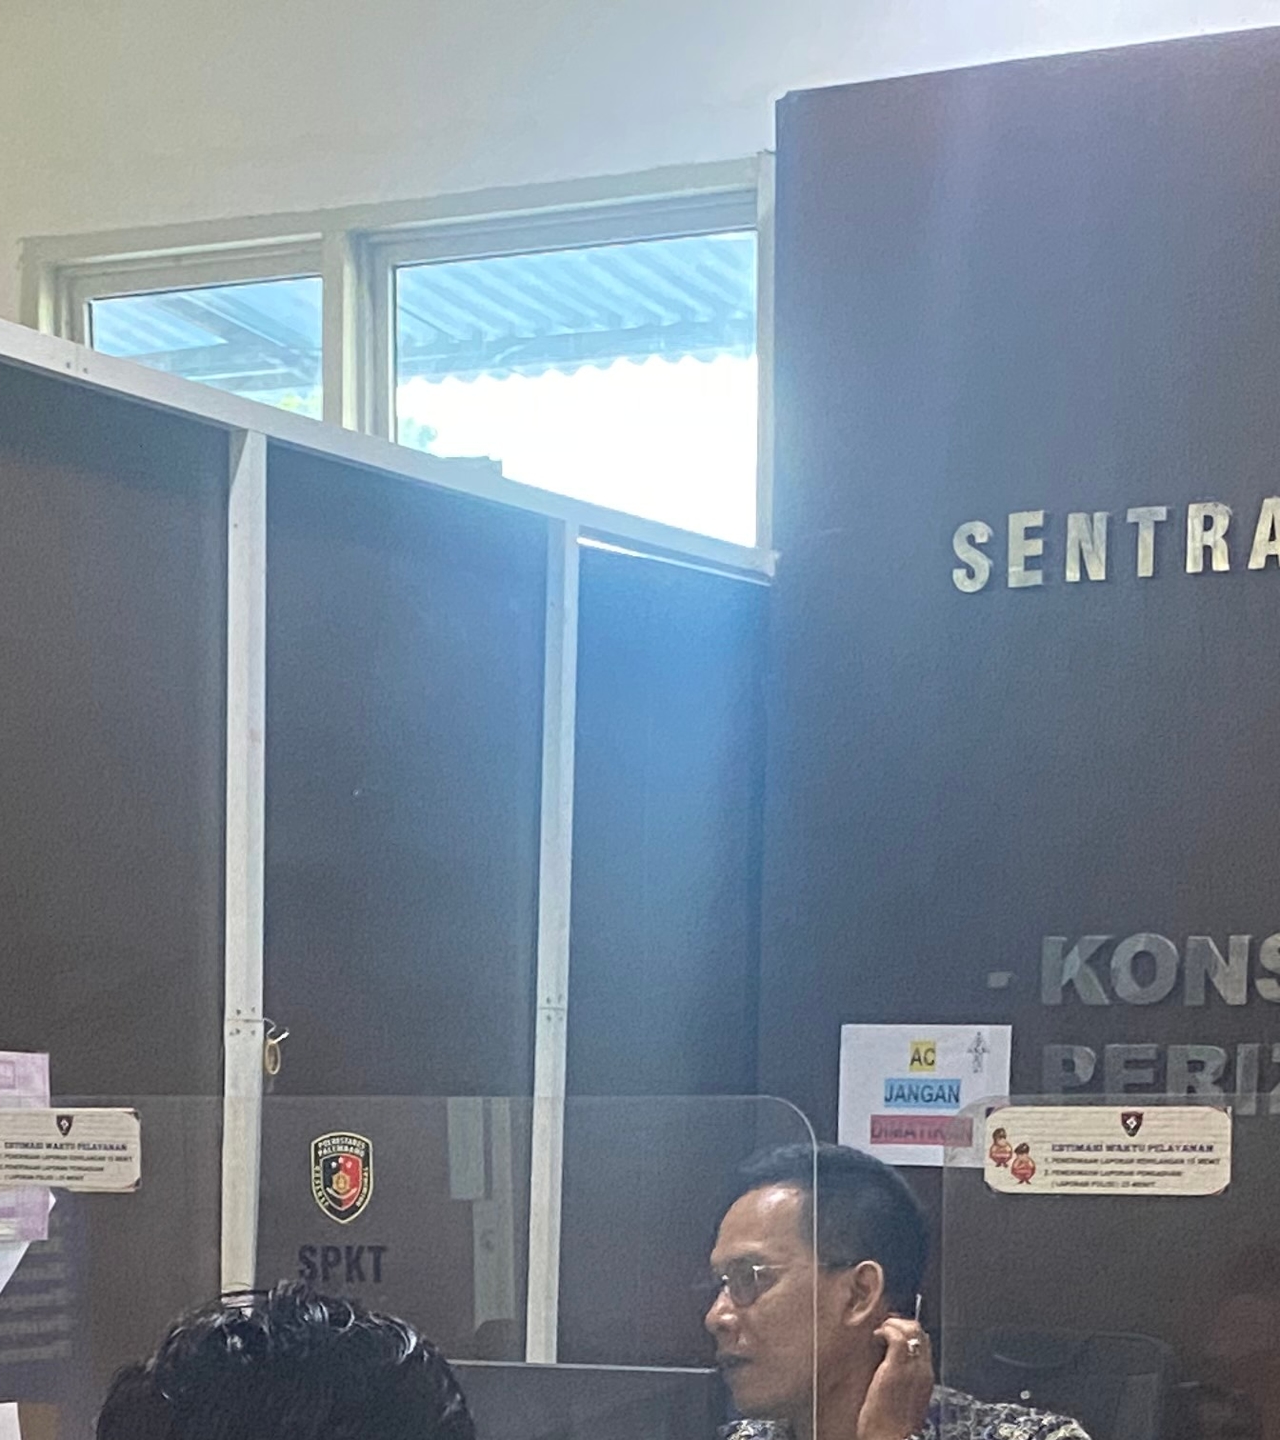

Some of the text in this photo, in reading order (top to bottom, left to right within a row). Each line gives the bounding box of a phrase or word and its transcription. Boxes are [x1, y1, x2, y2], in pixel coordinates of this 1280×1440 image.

[910, 1047, 935, 1066] AC
[884, 1084, 960, 1103] JANGAN
[1052, 1143, 1213, 1153] ESTIMASI WAKTU PELAYANAN
[298, 1245, 388, 1285] SPKT
